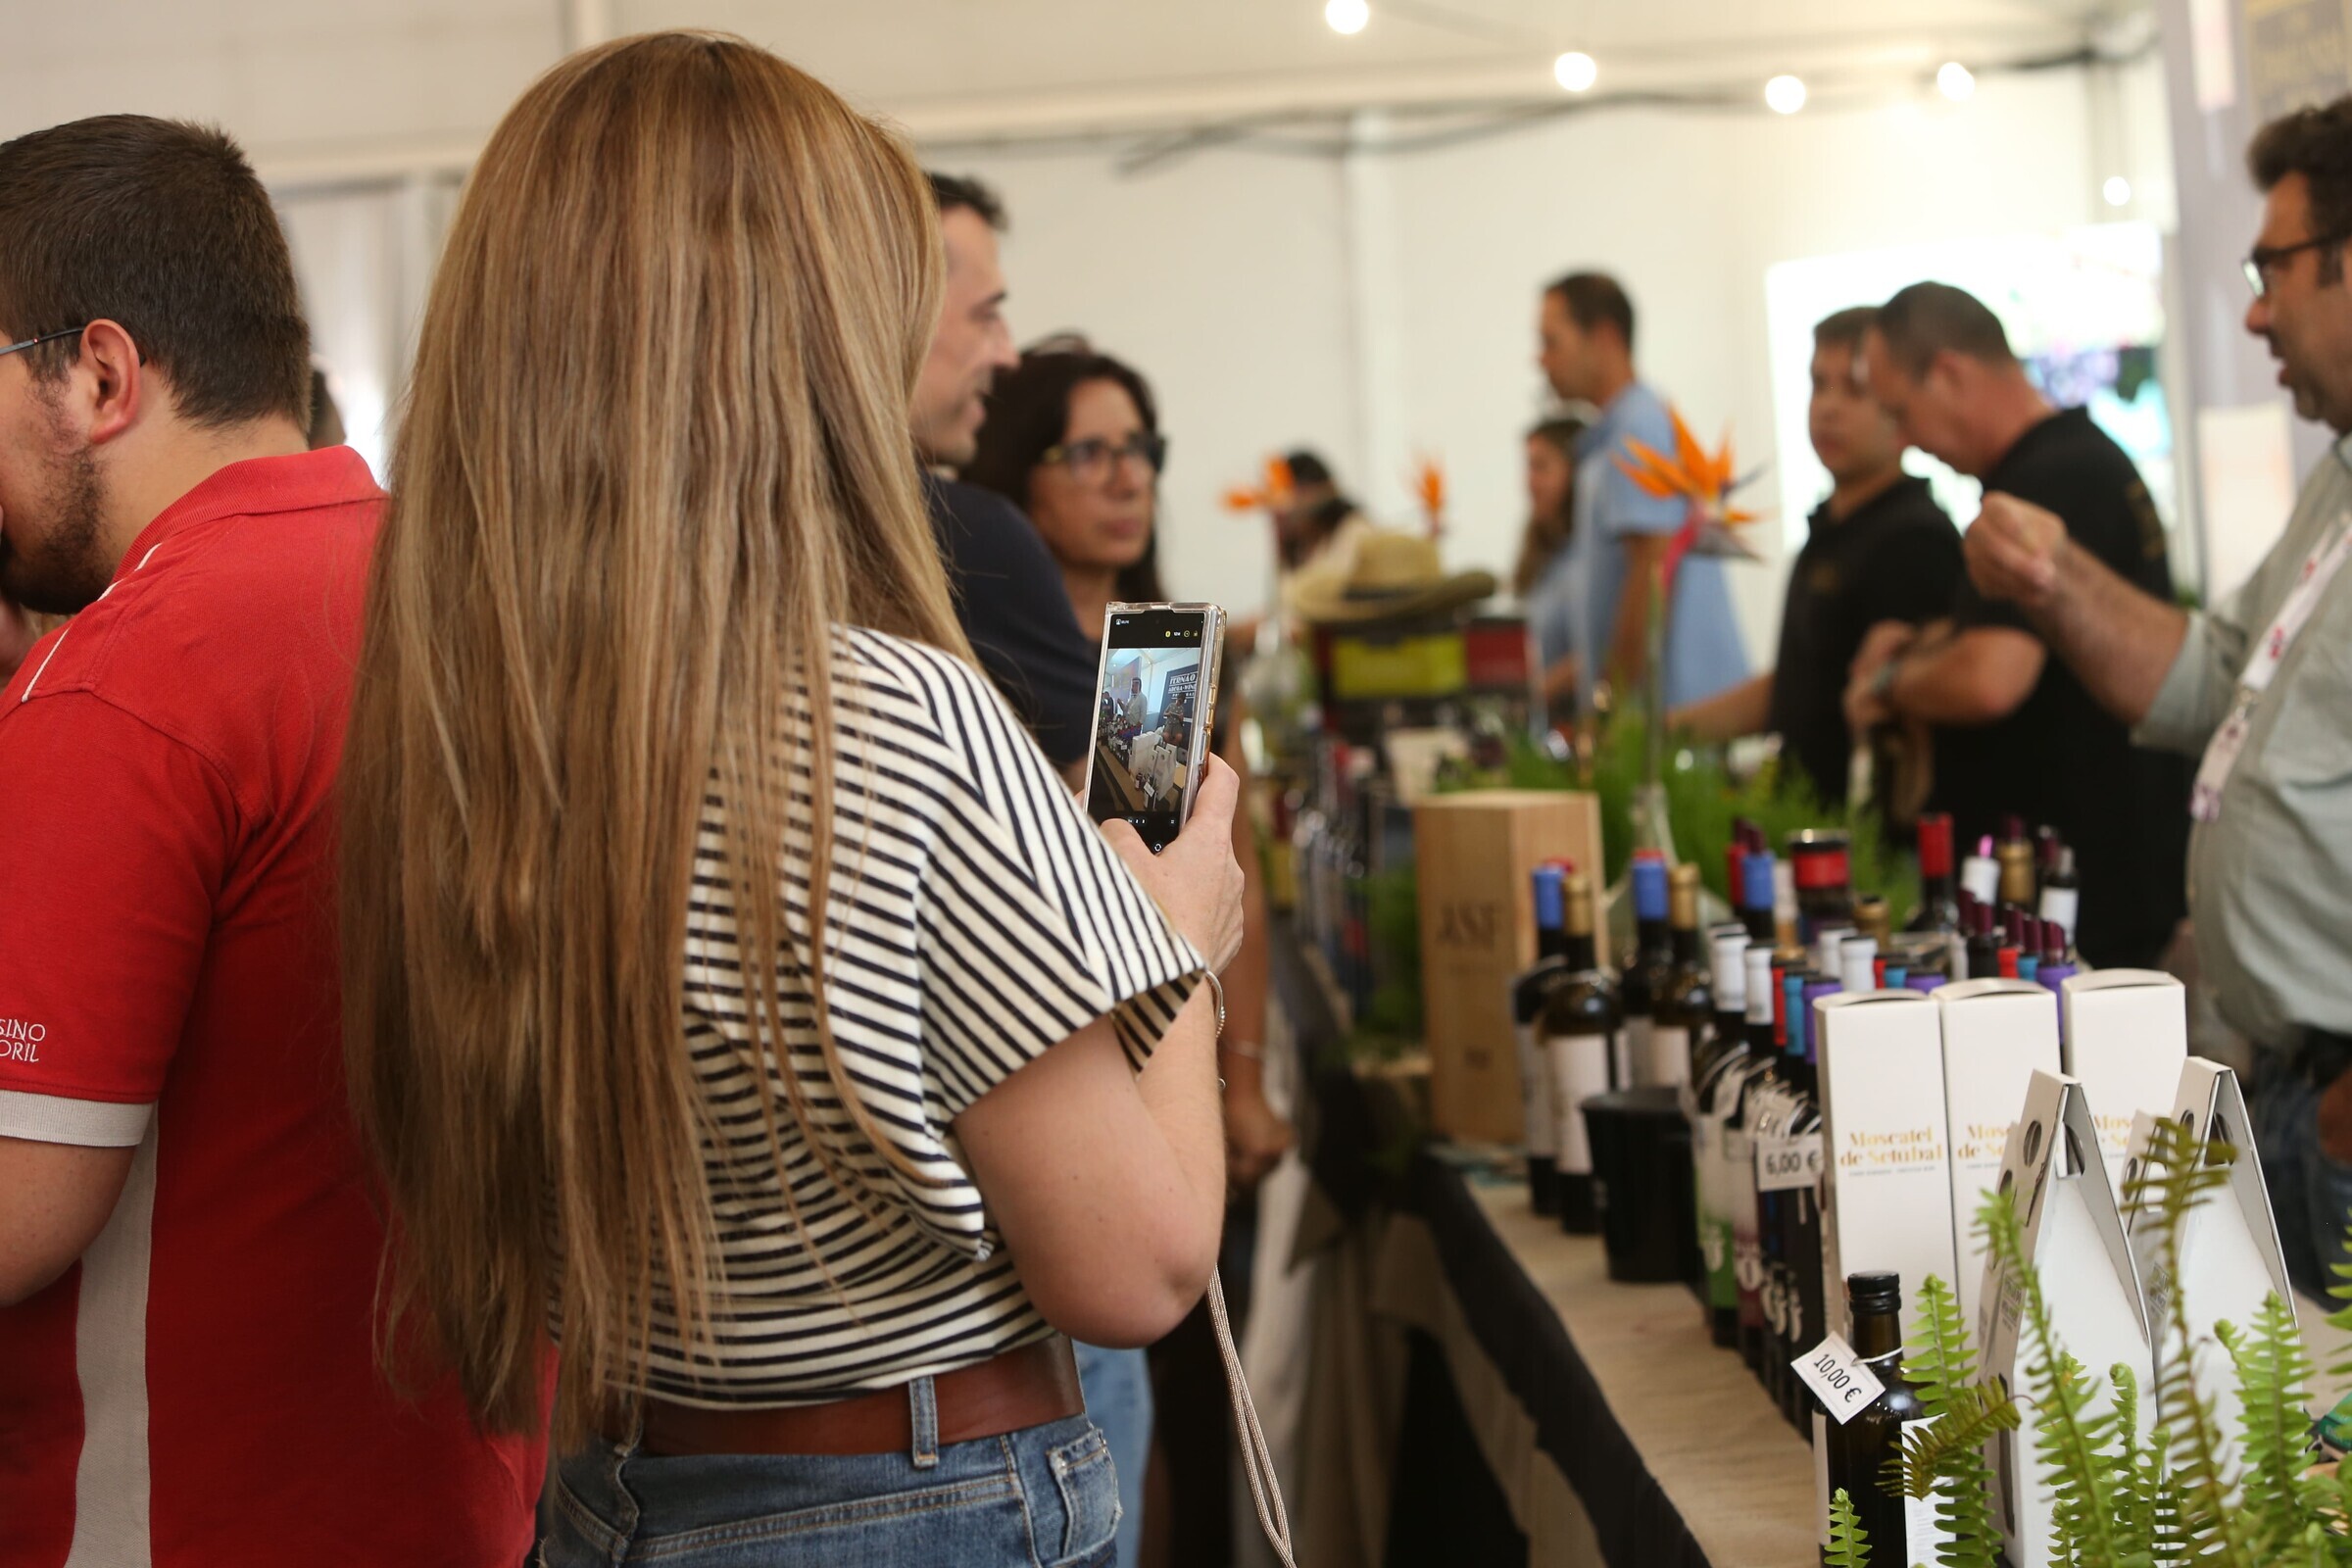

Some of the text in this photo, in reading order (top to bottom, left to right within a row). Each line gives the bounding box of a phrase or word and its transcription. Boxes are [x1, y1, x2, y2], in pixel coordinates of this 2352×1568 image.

[1849, 1126, 1933, 1147] Moscatel
[1765, 1152, 1802, 1178] 6,00
[1840, 1149, 1863, 1166] de
[1813, 1353, 1862, 1403] 10,00 €
